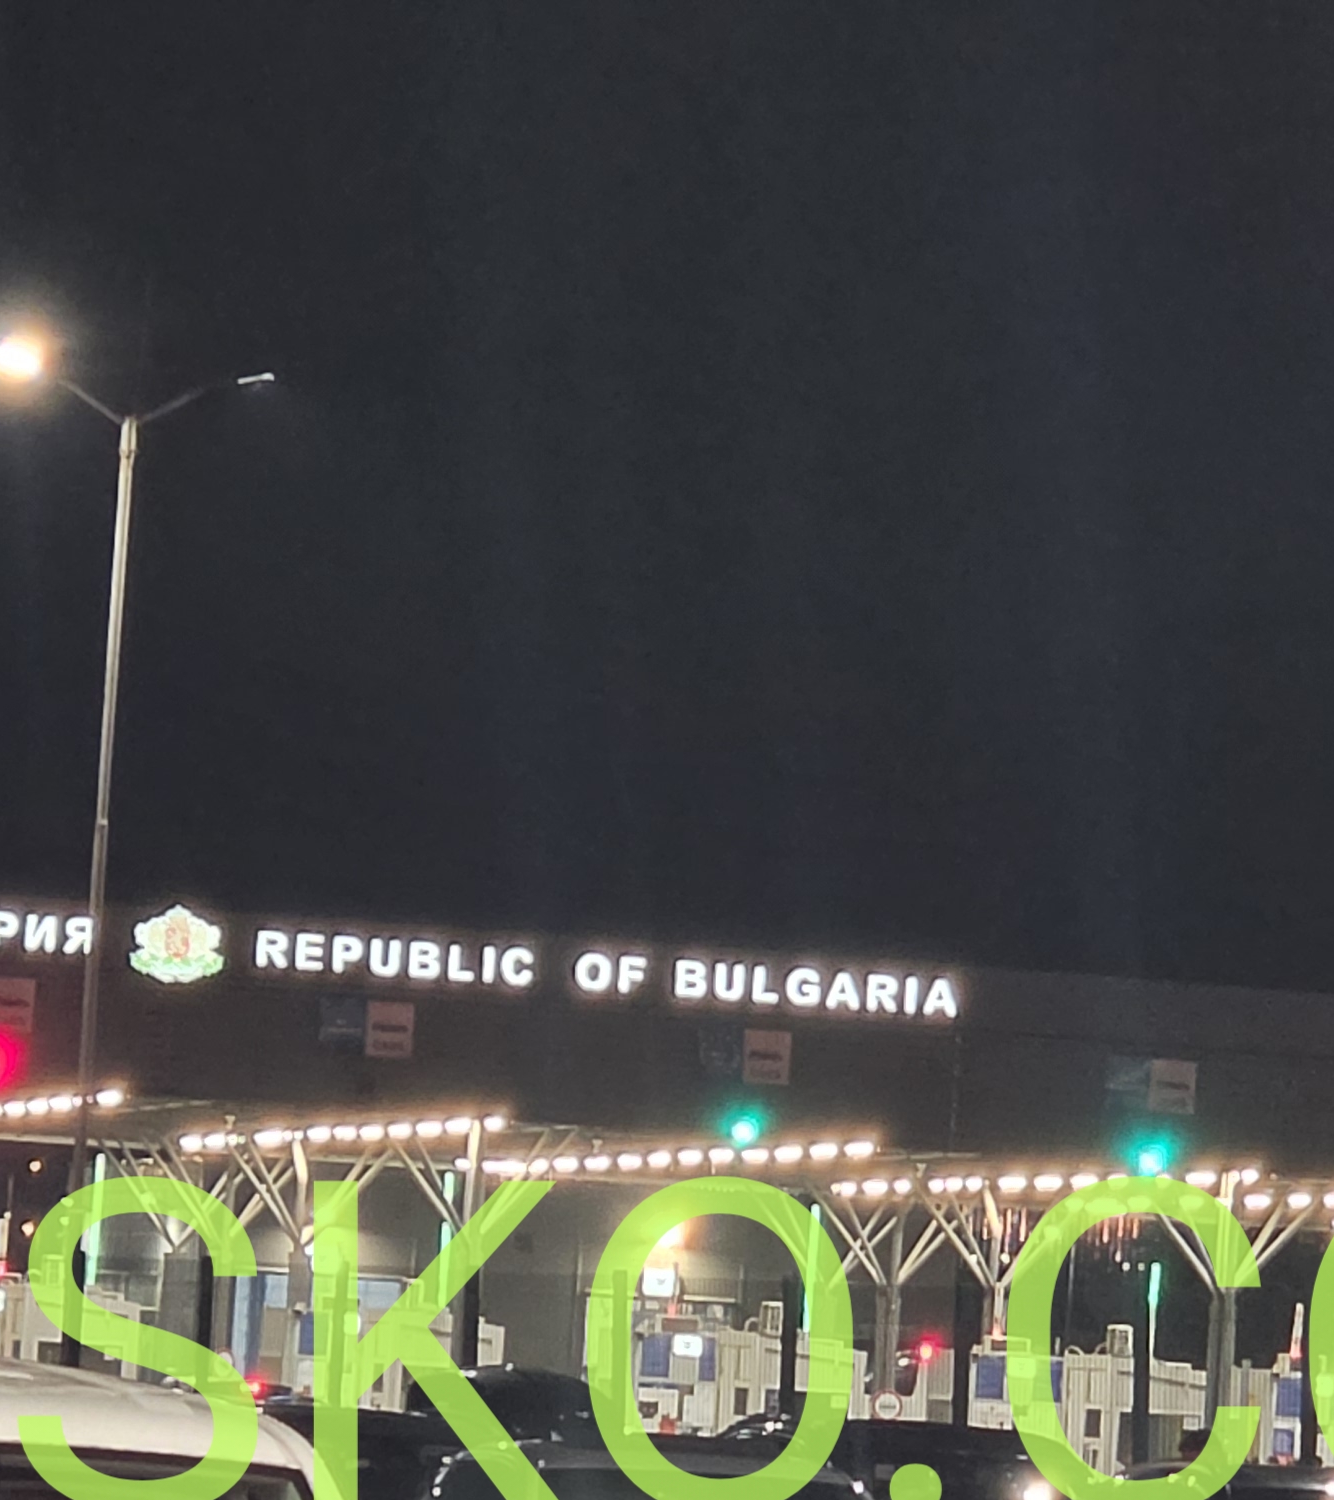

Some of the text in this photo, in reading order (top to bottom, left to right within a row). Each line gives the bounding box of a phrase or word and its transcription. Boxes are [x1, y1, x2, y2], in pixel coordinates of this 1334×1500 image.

[254, 928, 959, 1019] REPUBLIC OF BULGARIA
